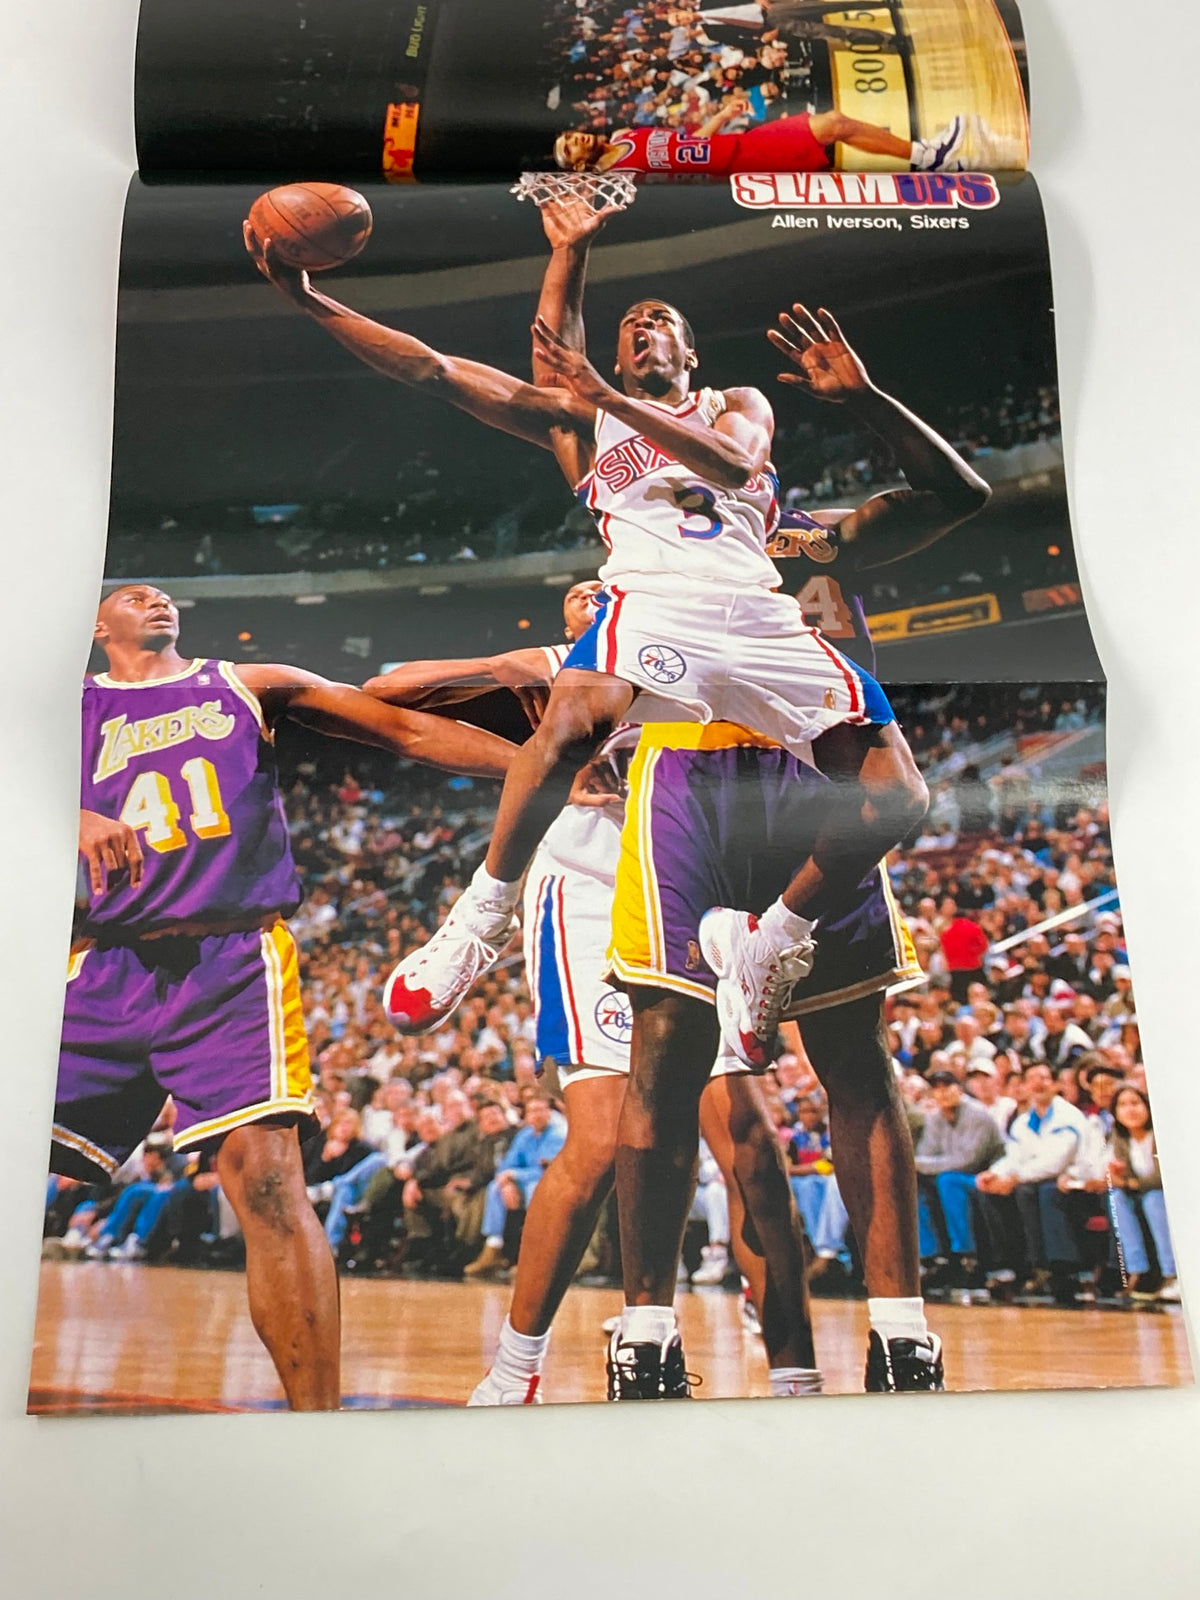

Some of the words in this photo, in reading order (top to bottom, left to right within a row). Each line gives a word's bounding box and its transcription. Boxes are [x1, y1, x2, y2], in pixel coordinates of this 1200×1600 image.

[731, 172, 1000, 210] SLAMUPS
[771, 214, 819, 230] Allen
[826, 214, 903, 232] Iverson,
[910, 214, 970, 230] Sixers
[674, 485, 723, 541] 3
[768, 528, 839, 564] ERS
[796, 574, 856, 638] 4
[93, 699, 235, 785] LAKERS
[119, 756, 232, 853] 41
